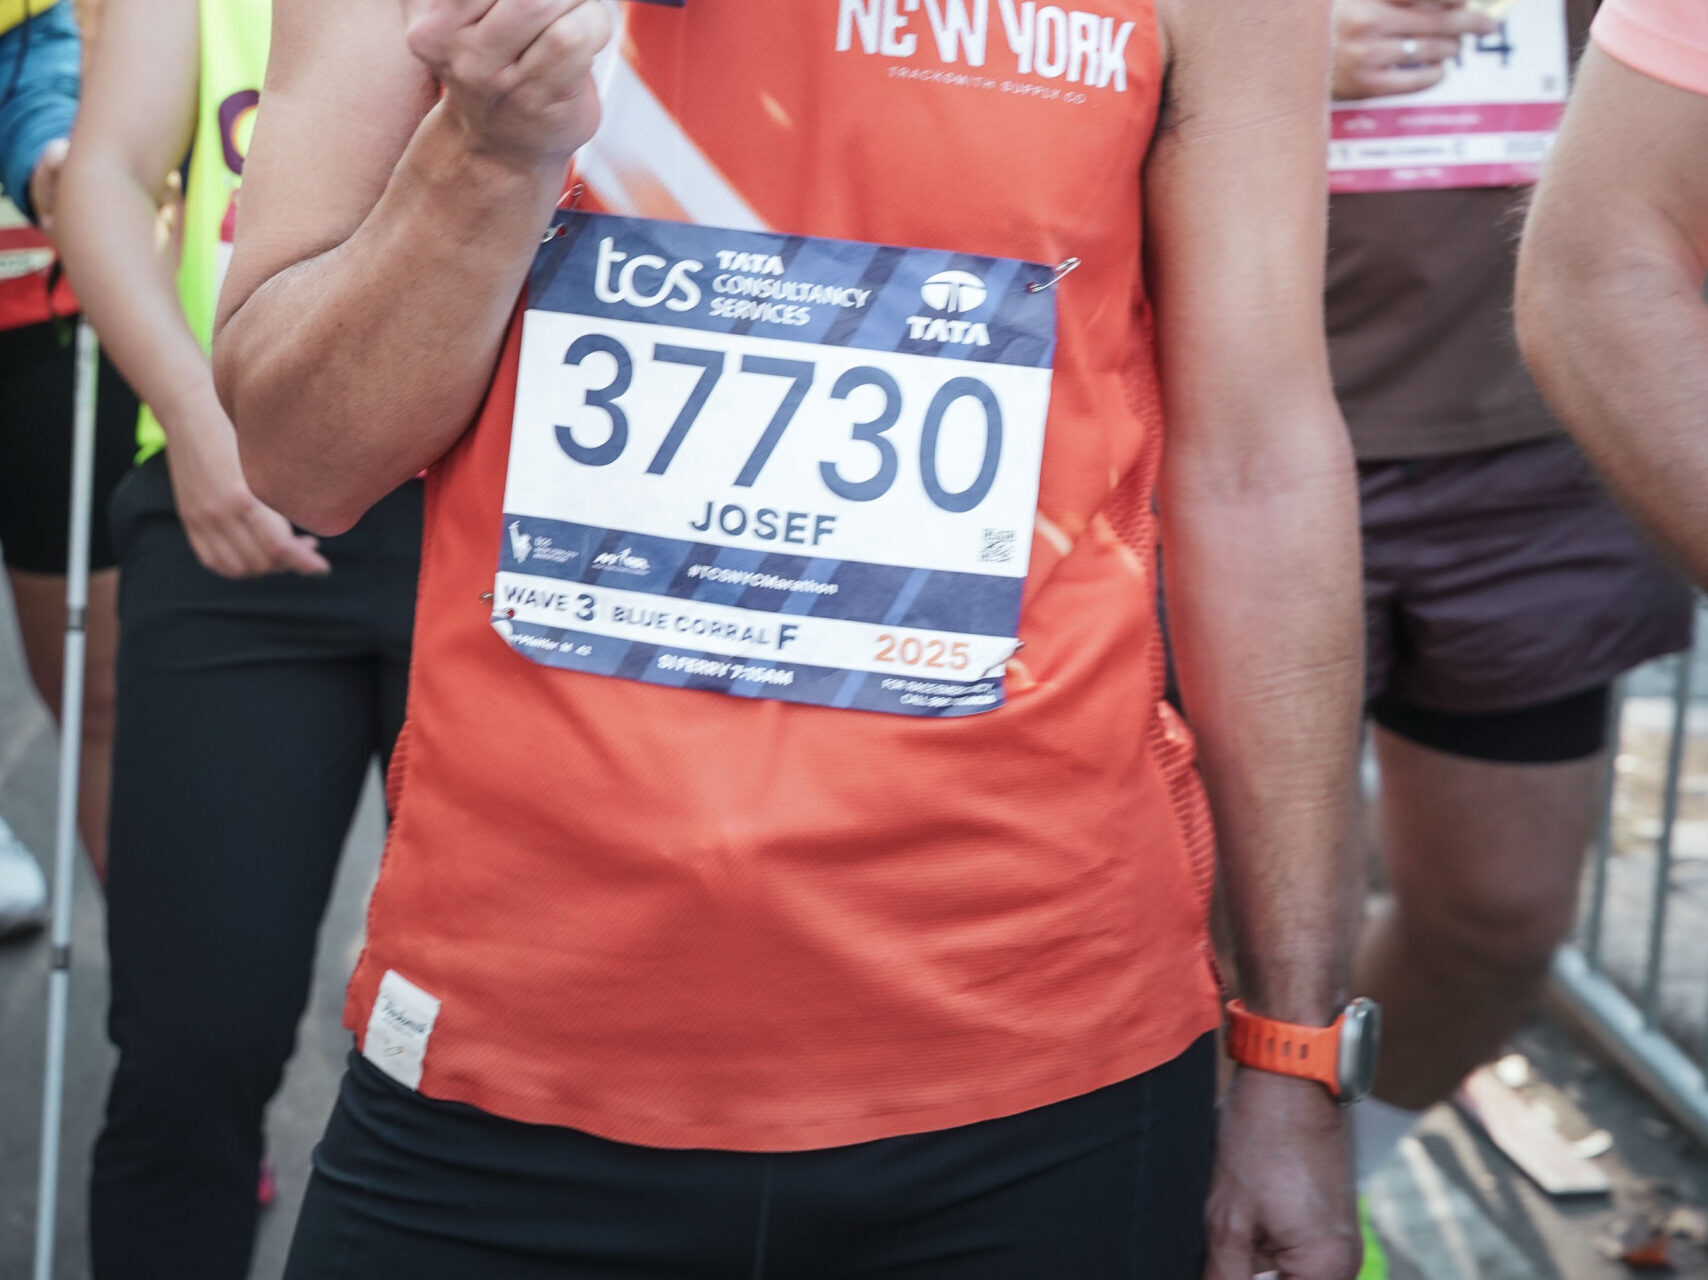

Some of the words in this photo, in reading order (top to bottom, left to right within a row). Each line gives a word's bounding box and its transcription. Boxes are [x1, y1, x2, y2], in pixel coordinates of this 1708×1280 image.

[594, 236, 704, 313] tcs
[716, 249, 785, 277] TATA
[711, 273, 873, 309] CONSULTANCY
[709, 296, 812, 327] SERVICES
[906, 316, 992, 347] TATA
[553, 333, 1004, 514] 37730
[689, 500, 838, 547] JOSEF
[503, 584, 570, 612] WAVE
[574, 592, 596, 622] 3
[611, 605, 671, 631] BLUE
[673, 615, 771, 645] CORRAL
[776, 623, 801, 651] F
[873, 633, 971, 671] 2025
